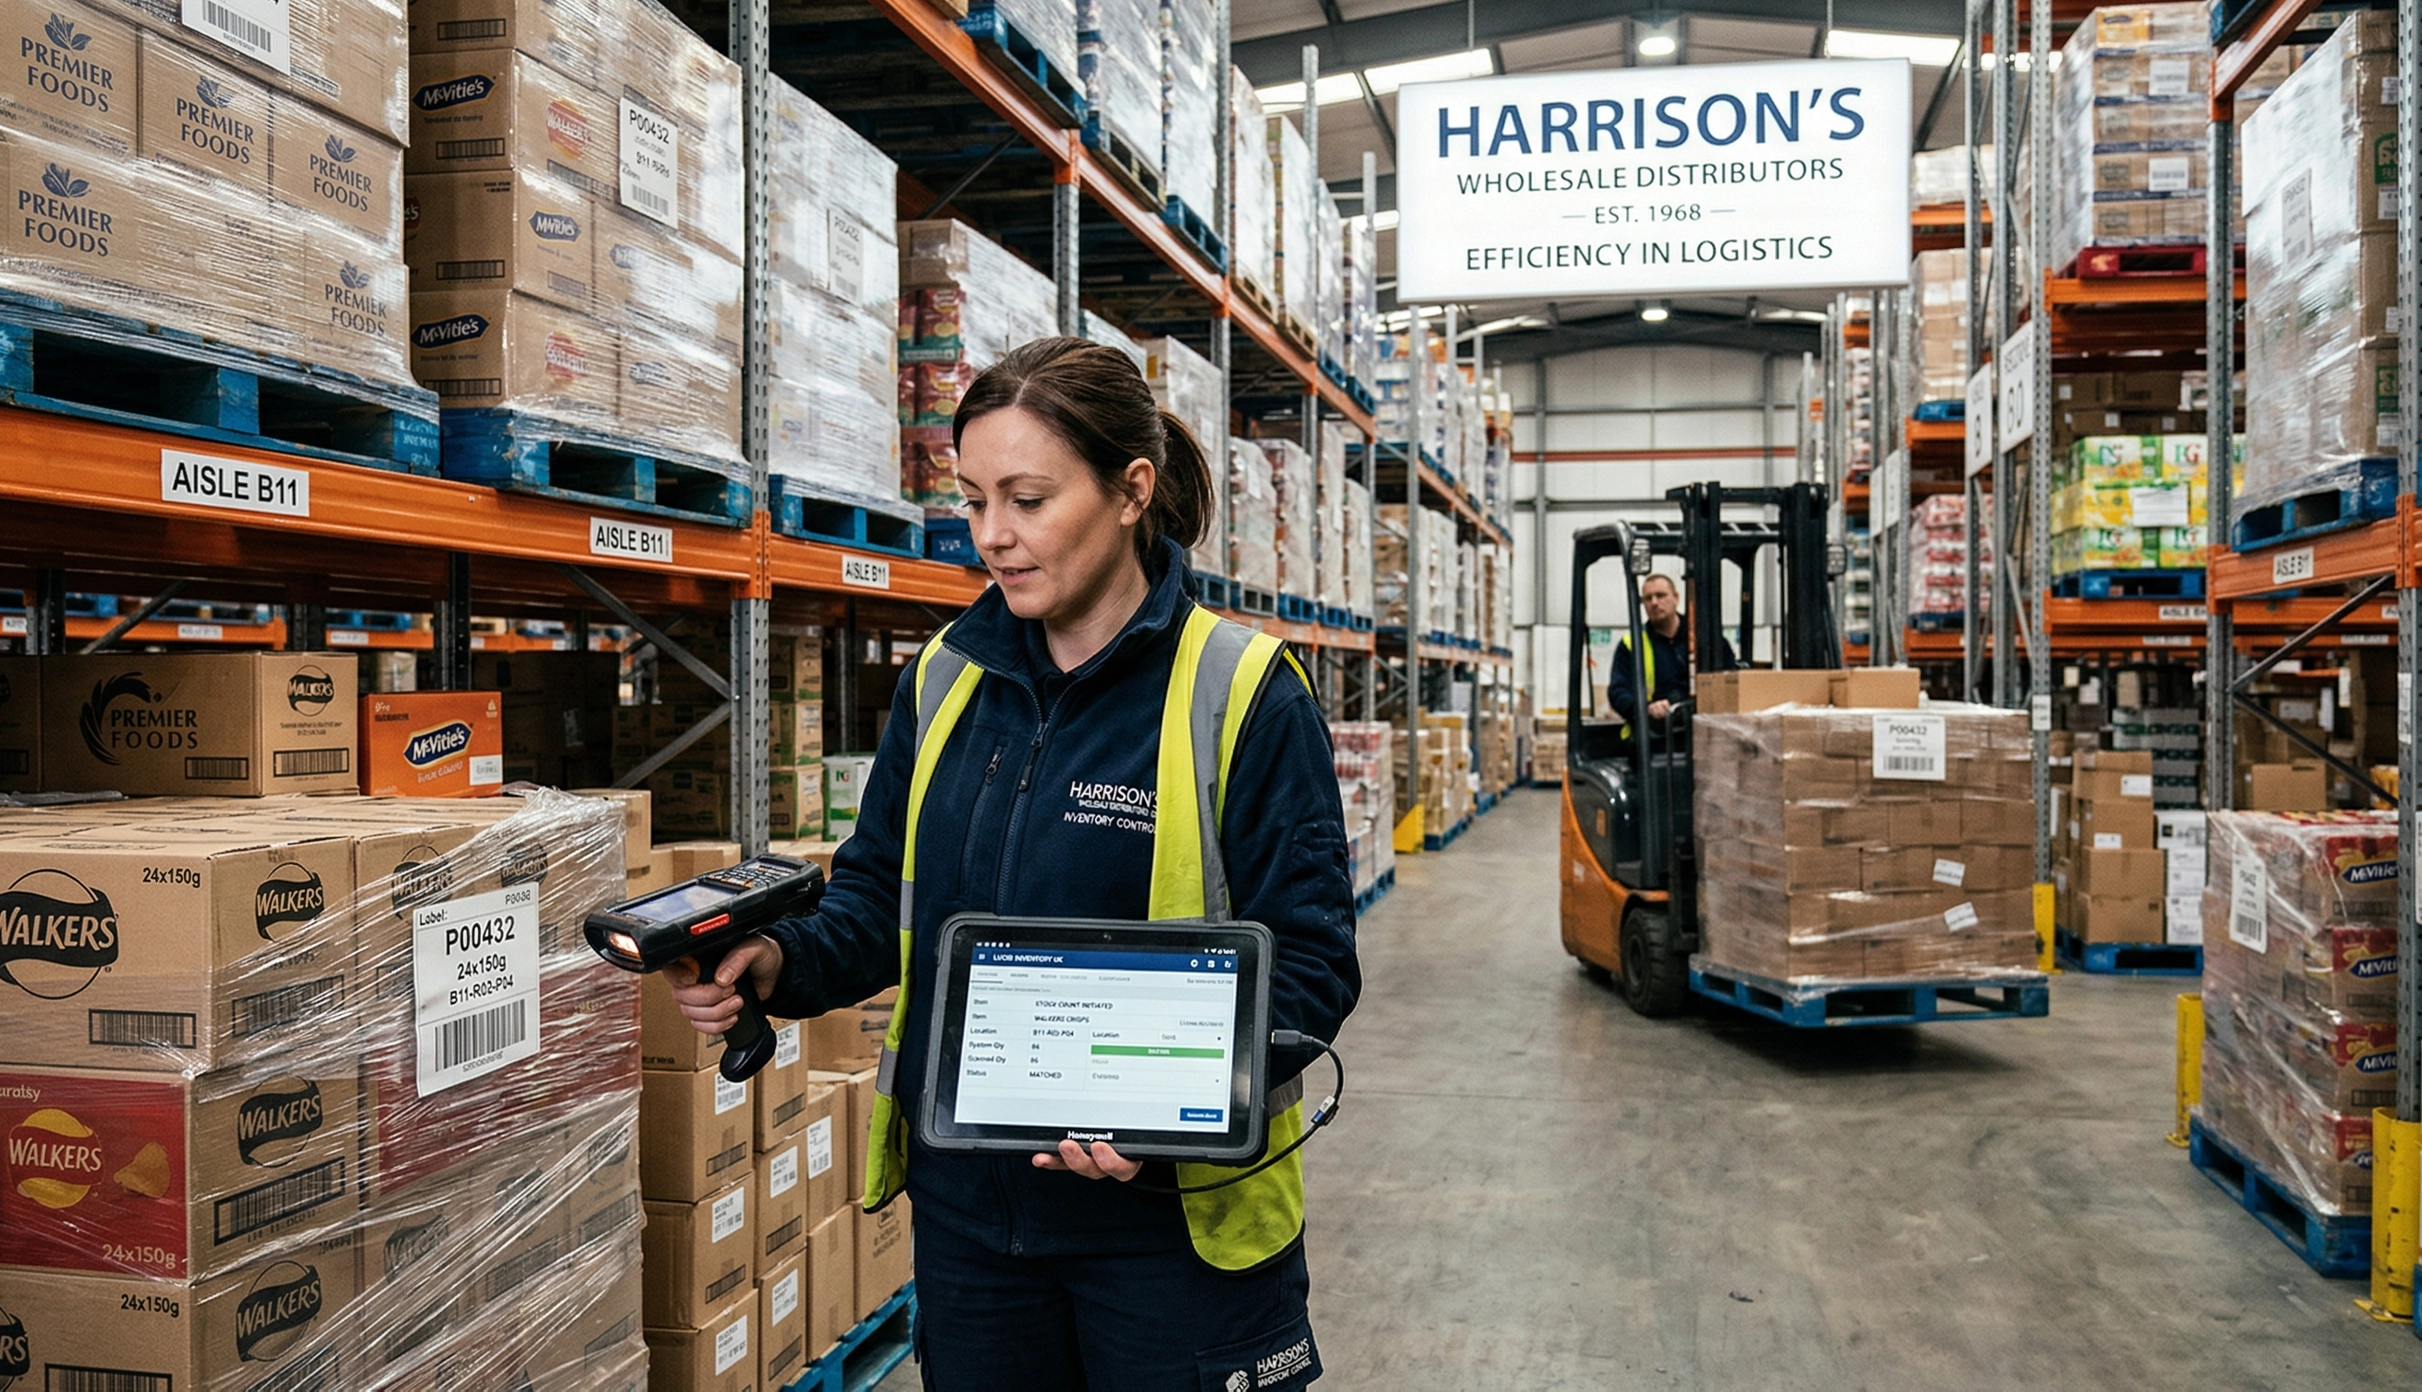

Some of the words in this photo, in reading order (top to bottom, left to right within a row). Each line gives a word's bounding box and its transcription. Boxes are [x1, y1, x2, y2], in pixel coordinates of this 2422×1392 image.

[21, 36, 113, 91] PREMIER
[28, 65, 109, 113] FOODS
[176, 97, 254, 146] PREMIER
[1437, 86, 1866, 159] HARRISON'S
[180, 122, 250, 165] FOODS
[309, 153, 372, 195] PREMIER
[1457, 166, 1627, 195] WHOLESALE
[1637, 157, 1844, 188] DISTRIBUTORS
[18, 189, 113, 236] PREMIER
[313, 177, 368, 213] FOODS
[1594, 204, 1640, 224] EST.
[1648, 203, 1702, 223] 1968
[24, 218, 109, 257] FOODS
[1466, 242, 1632, 271] EFFICIENCY
[1641, 242, 1671, 264] IN
[1680, 235, 1834, 263] LOGISTICS
[331, 306, 386, 337] FOODS
[172, 460, 249, 500] AISLE
[258, 475, 298, 506] B11
[595, 524, 637, 552] AISLE
[641, 530, 664, 555] B11
[845, 560, 870, 582] AISLE
[111, 709, 198, 728] PREMIER
[111, 731, 198, 750] FOODS
[412, 727, 465, 761] McVitie's
[143, 867, 201, 888] 24x150g
[257, 884, 323, 918] WALKERS
[419, 908, 448, 926] Label:
[0, 906, 117, 952] WALKERS
[445, 915, 515, 956] P00432
[457, 954, 507, 981] 24x150g
[449, 974, 514, 1006] B11-R02-P04
[1029, 1071, 1063, 1079] MATCHED
[239, 1094, 321, 1140] WALKERS
[9, 1137, 102, 1172] WALKERS
[102, 1243, 177, 1269] 24x150g
[120, 1293, 180, 1318] 24x150g
[237, 1278, 321, 1340] WALKERS
